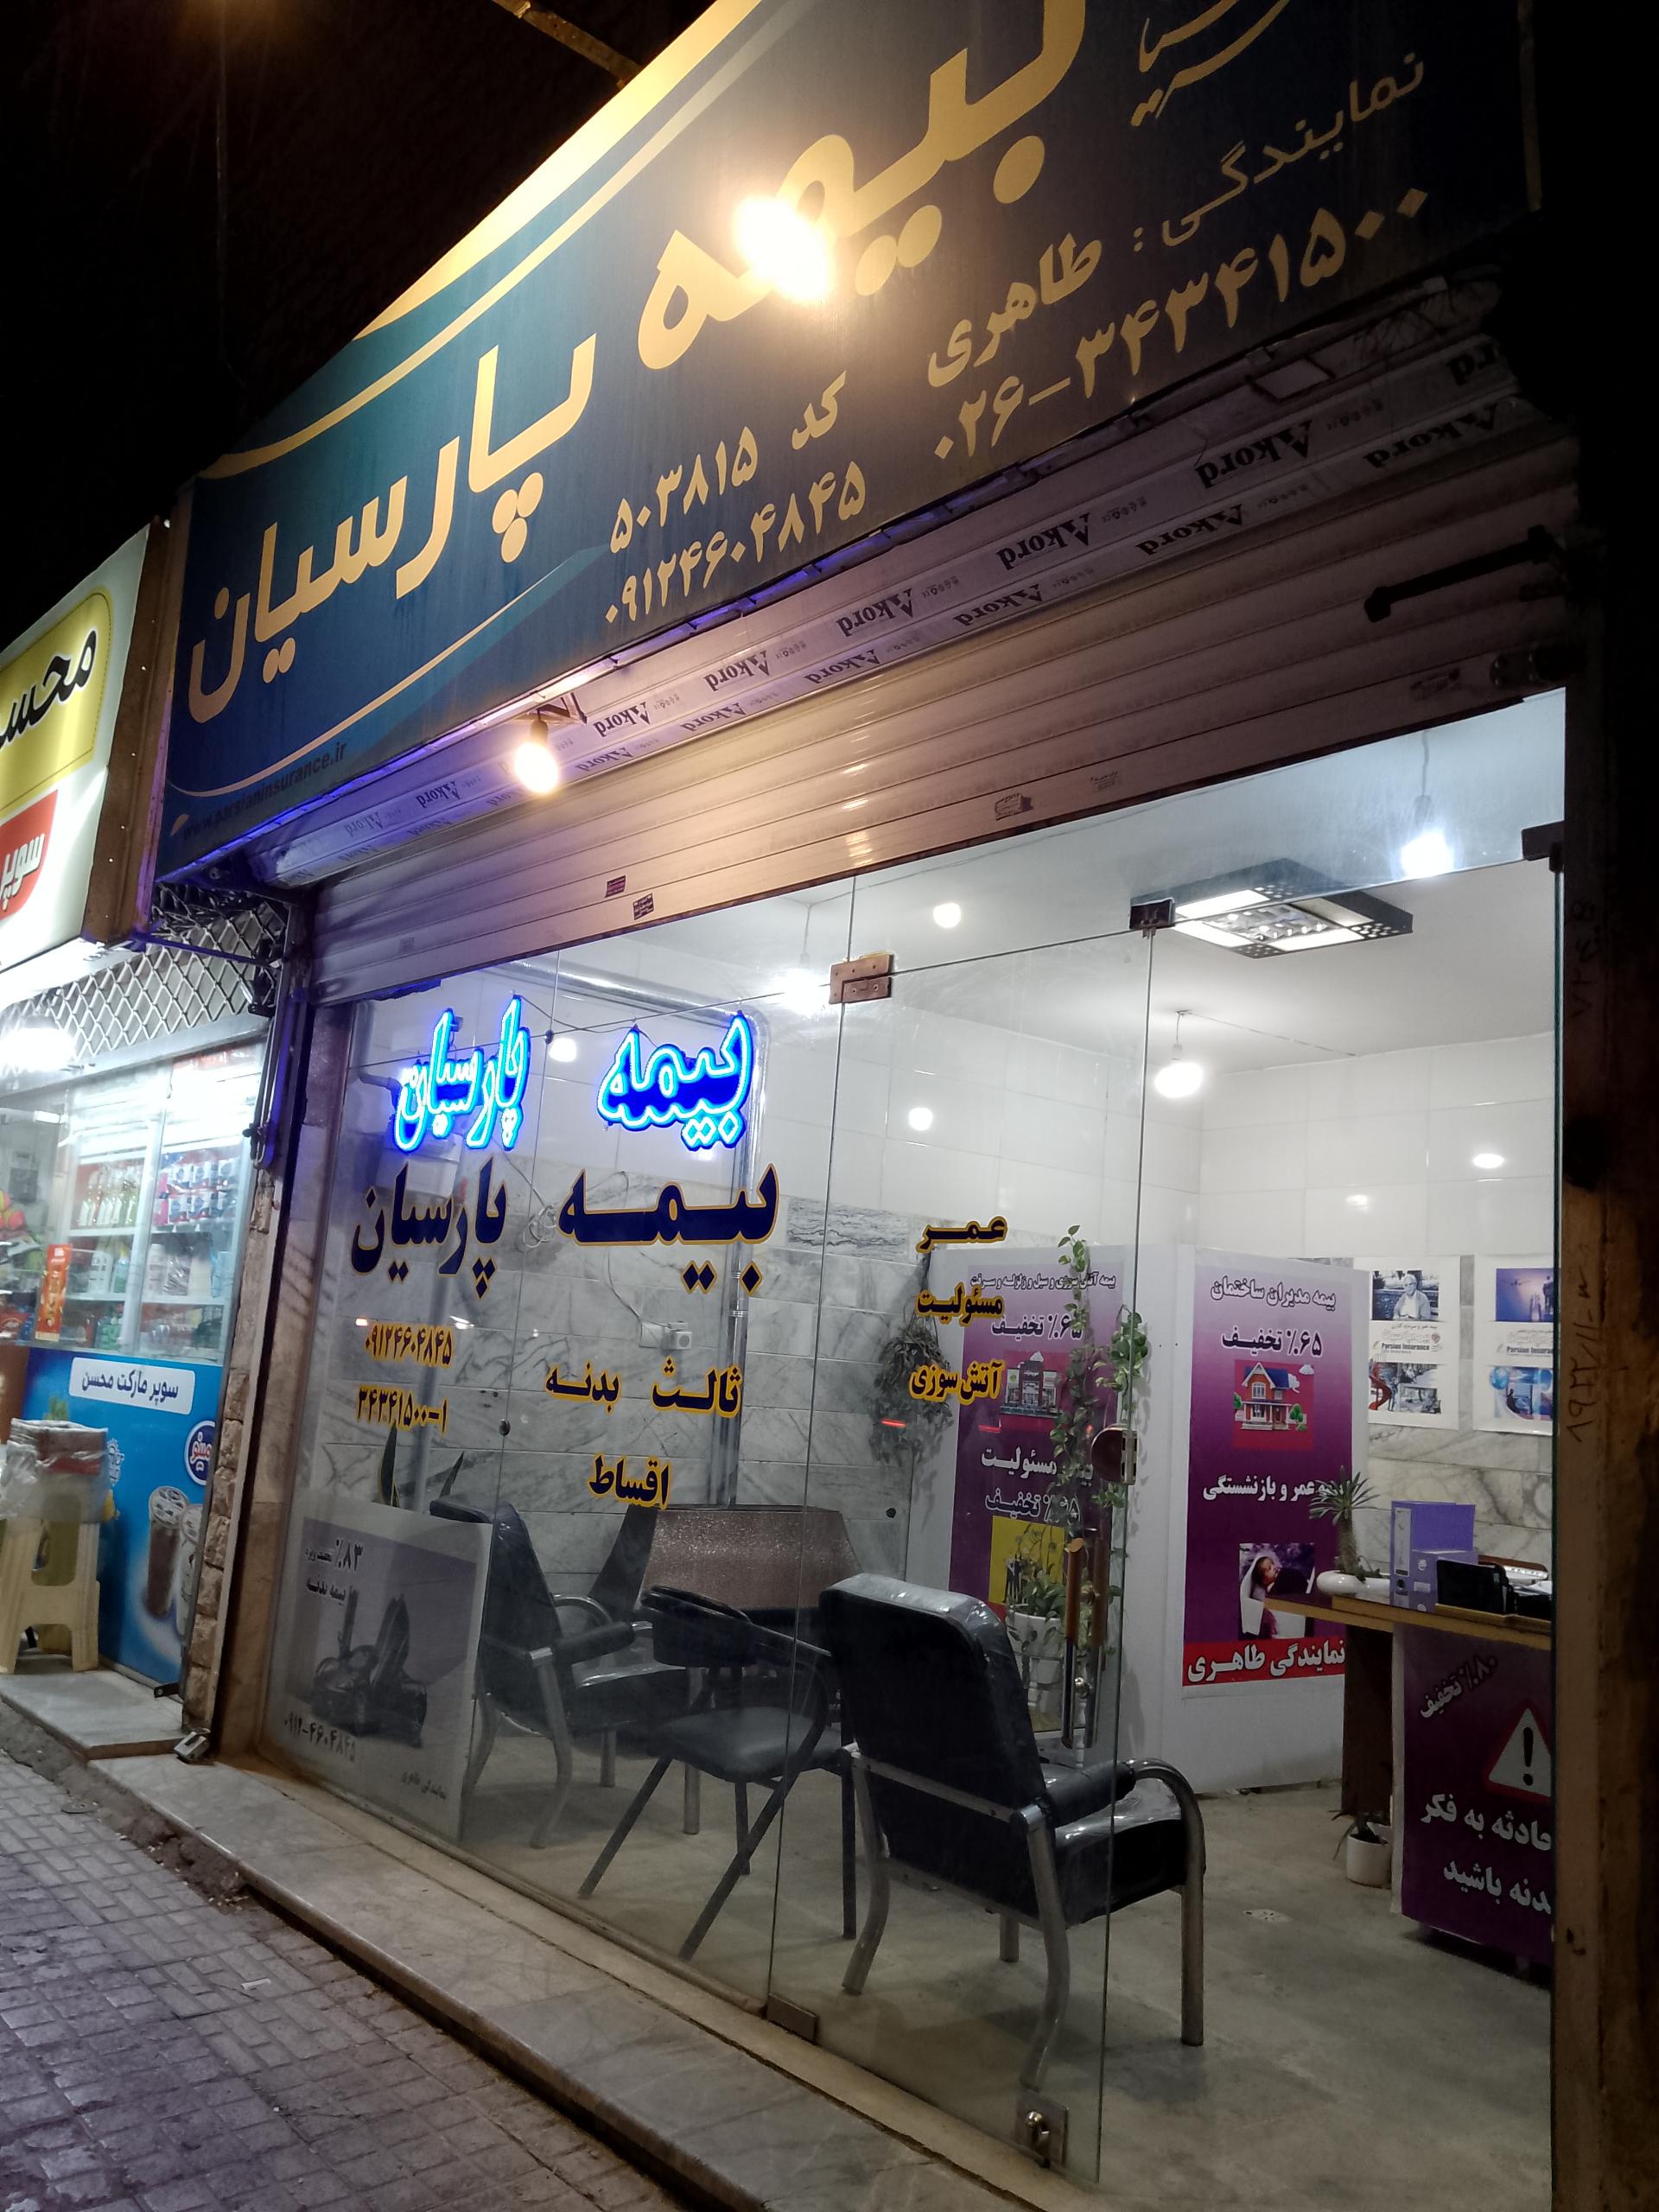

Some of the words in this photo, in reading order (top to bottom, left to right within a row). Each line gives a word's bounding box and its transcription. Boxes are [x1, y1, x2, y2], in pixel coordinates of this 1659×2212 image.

[638, 0, 1086, 370] بیمه
[927, 233, 1102, 388] طاهری
[791, 370, 847, 450] کد
[1196, 419, 1313, 489] Akord
[1363, 403, 1499, 468] Akord
[610, 426, 759, 554] ۵۰۳۸۱۵
[188, 333, 597, 722] پارسیان
[605, 460, 867, 625] ۰۹۱۲۴۶۰۴۸۴۵
[995, 512, 1092, 571] Akord
[1135, 503, 1244, 556] Akord
[836, 588, 914, 638] Akord
[953, 582, 1043, 626] Akord
[702, 650, 771, 692] Akord
[804, 648, 883, 684] Akord
[0, 629, 99, 751] محس
[593, 700, 652, 738] Akord
[680, 702, 747, 732] Akord
[575, 746, 634, 772] Akord
[415, 779, 461, 810] Akord
[393, 995, 531, 1154] پارسیان
[595, 1013, 753, 1152] بیمه
[350, 1156, 507, 1300] پارسیان
[556, 1162, 780, 1295] بیمه
[916, 1217, 1008, 1253] عمر
[969, 1273, 996, 1290] سرقت
[1002, 1273, 1027, 1290] زلزله
[1033, 1273, 1050, 1290] سیل
[1099, 1274, 1116, 1290] بیمه
[1211, 1274, 1266, 1301] ساختمان
[1266, 1282, 1312, 1308] مدیران
[1312, 1289, 1337, 1312] بیمه
[916, 1283, 1006, 1325] مسئولیت
[365, 1322, 454, 1368] ۰۹۱۲۴۶۰۴۸۴۵
[992, 1315, 1045, 1340] تخفیف
[1221, 1325, 1283, 1356] تخفیف
[81, 1371, 114, 1391] محسن
[117, 1369, 148, 1399] مارکت
[148, 1381, 179, 1406] سوپر
[544, 1360, 621, 1414] بدنه
[650, 1356, 744, 1415] ثالث
[910, 1363, 959, 1402] سوزی
[959, 1359, 1005, 1403] آتش
[588, 1453, 671, 1510] اقساط
[981, 1446, 1058, 1479] مسئولیت
[985, 1487, 1042, 1520] تخفیف
[1203, 1474, 1277, 1502] بازنشستگی
[1278, 1483, 1287, 1502] و
[1290, 1480, 1315, 1503] عمر
[1187, 1643, 1266, 1682] طاهری
[1269, 1638, 1346, 1677] نمایندگی
[1420, 1675, 1463, 1719] تخفیف
[1420, 1793, 1458, 1824] فکر
[1463, 1808, 1485, 1840] به
[1443, 1860, 1503, 1905] باشید
